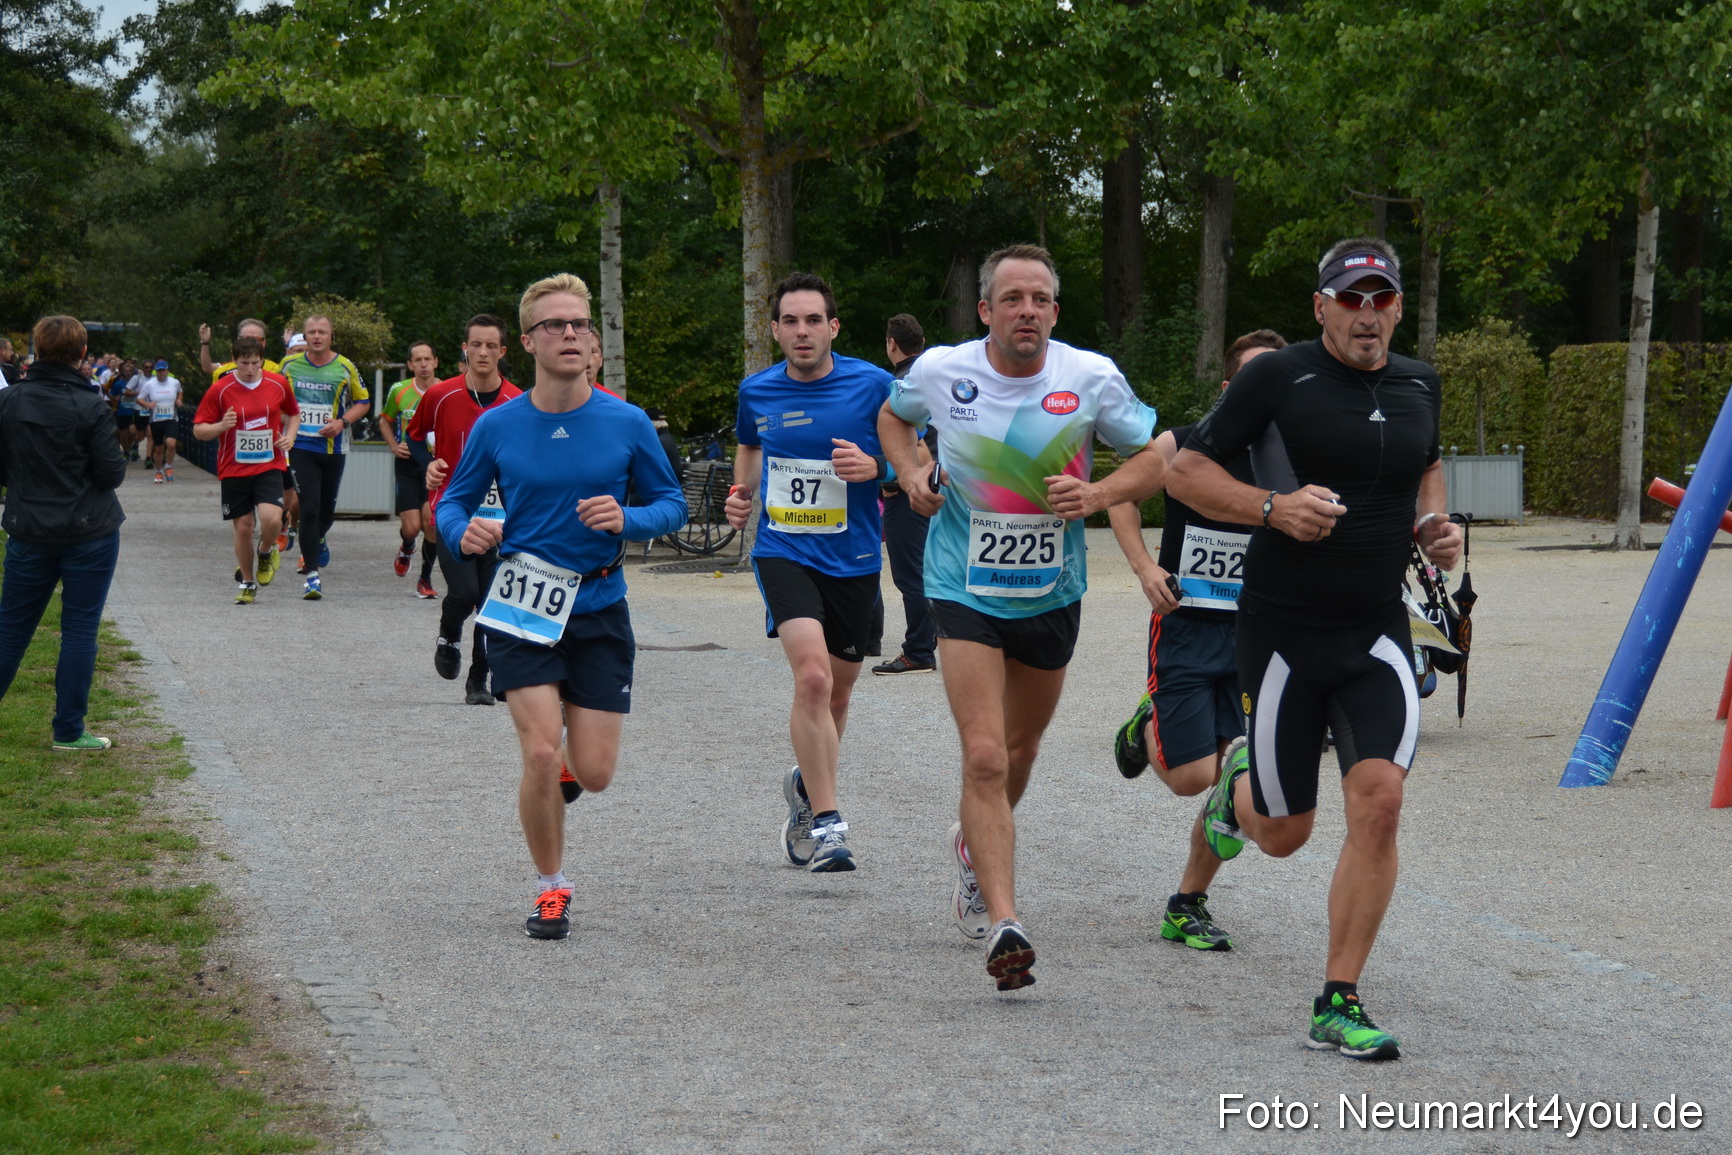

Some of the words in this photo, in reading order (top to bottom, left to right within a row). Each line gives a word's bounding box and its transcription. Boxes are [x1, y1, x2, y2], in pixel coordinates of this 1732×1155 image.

[297, 380, 332, 391] BOCK
[1047, 397, 1076, 409] Hervis
[300, 411, 330, 425] 3116
[950, 406, 978, 417] PARTL
[950, 414, 978, 422] Neumarkt
[240, 438, 270, 451] 2581
[770, 464, 793, 474] PARTL
[795, 466, 832, 476] Neumarkt
[487, 488, 497, 506] 5
[790, 477, 821, 505] 87
[475, 509, 497, 517] lorian
[784, 511, 827, 524] Michael
[972, 518, 1004, 530] PARTL
[1006, 521, 1050, 531] Neumarkt
[1186, 533, 1215, 546] PARTL
[1217, 539, 1248, 549] Neuma
[978, 532, 1055, 565] 2225
[1189, 547, 1246, 579] 252
[526, 562, 565, 584] Neumarkt
[990, 572, 1042, 586] Andreas
[499, 569, 567, 617] 3119
[1209, 584, 1238, 599] Timo
